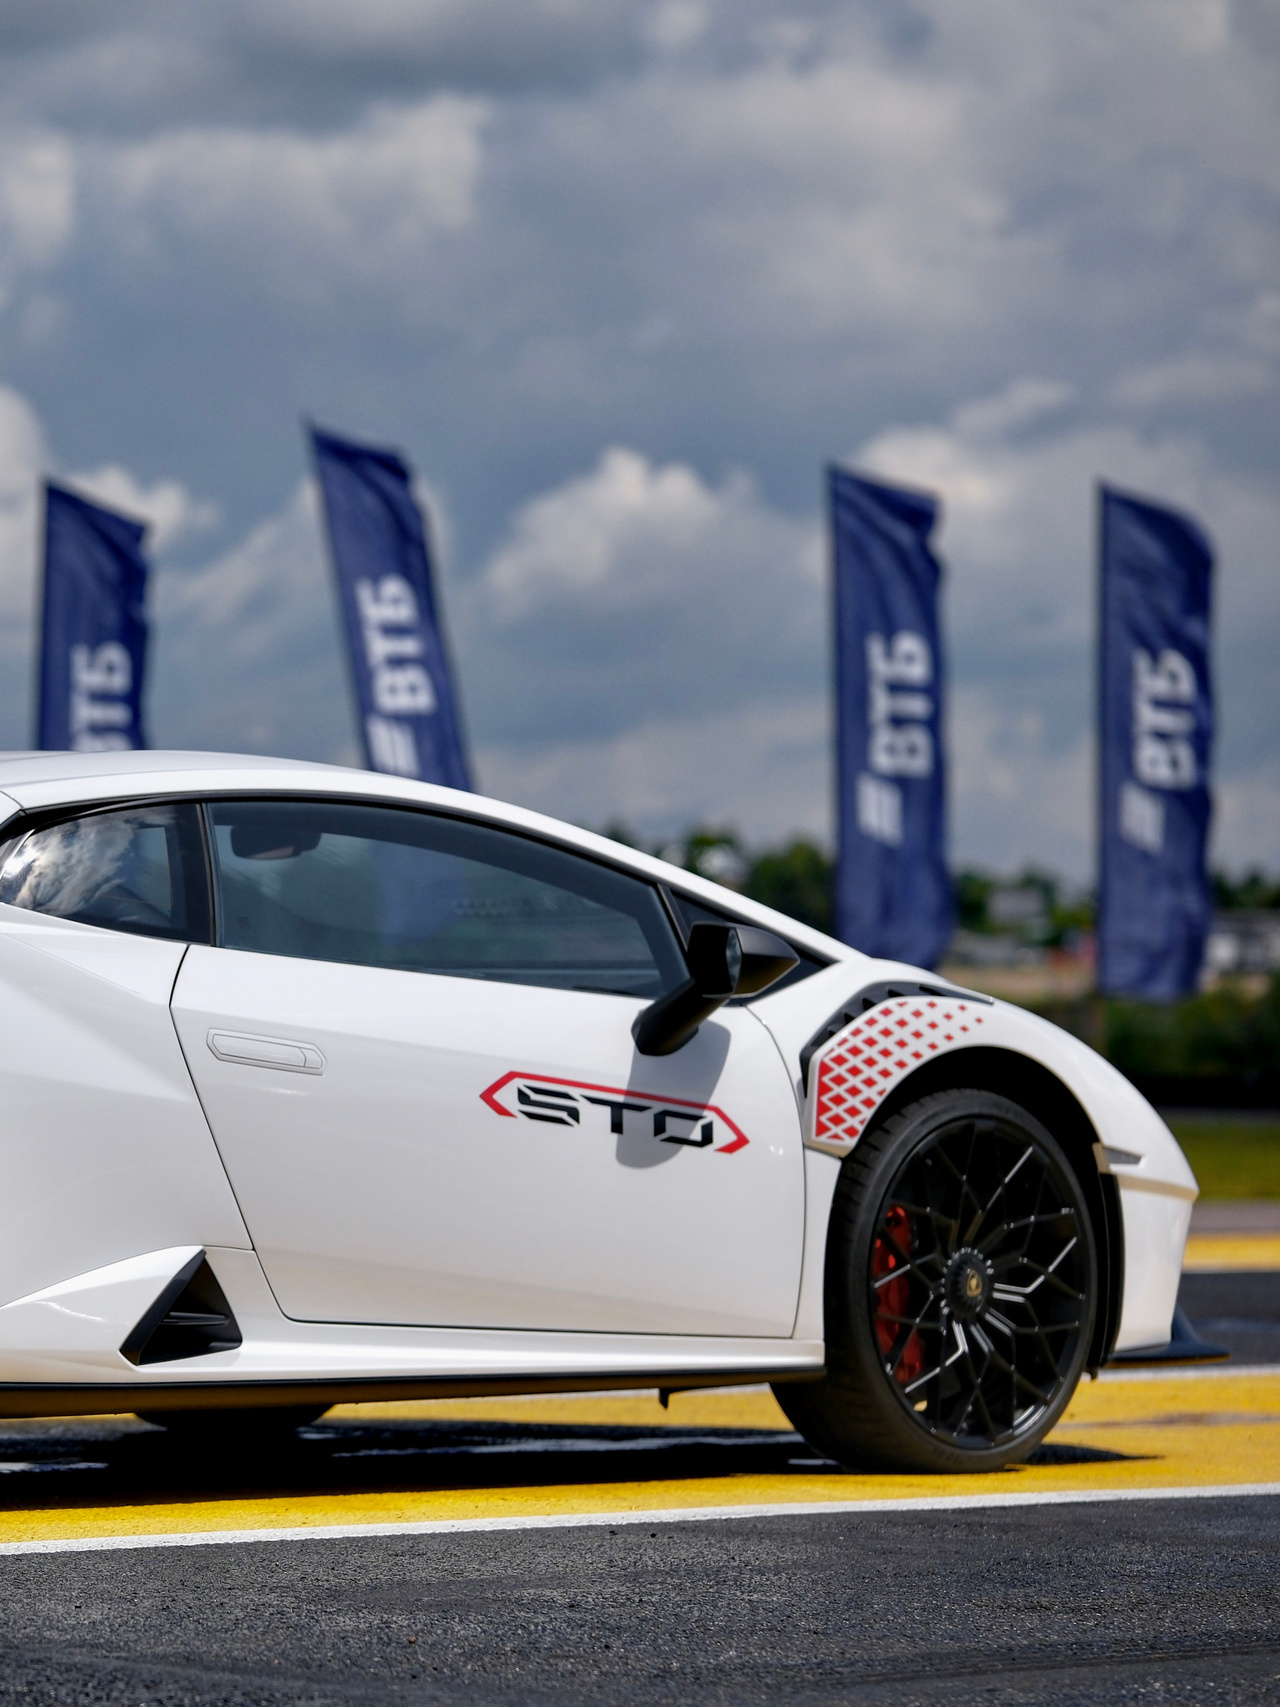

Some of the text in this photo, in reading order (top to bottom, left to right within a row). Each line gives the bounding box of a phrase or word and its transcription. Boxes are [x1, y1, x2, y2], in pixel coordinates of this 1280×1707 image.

[356, 574, 436, 714] ВТБ
[867, 632, 933, 777] ВТБ
[1132, 648, 1197, 789] ВТБ
[517, 1084, 713, 1148] STO
